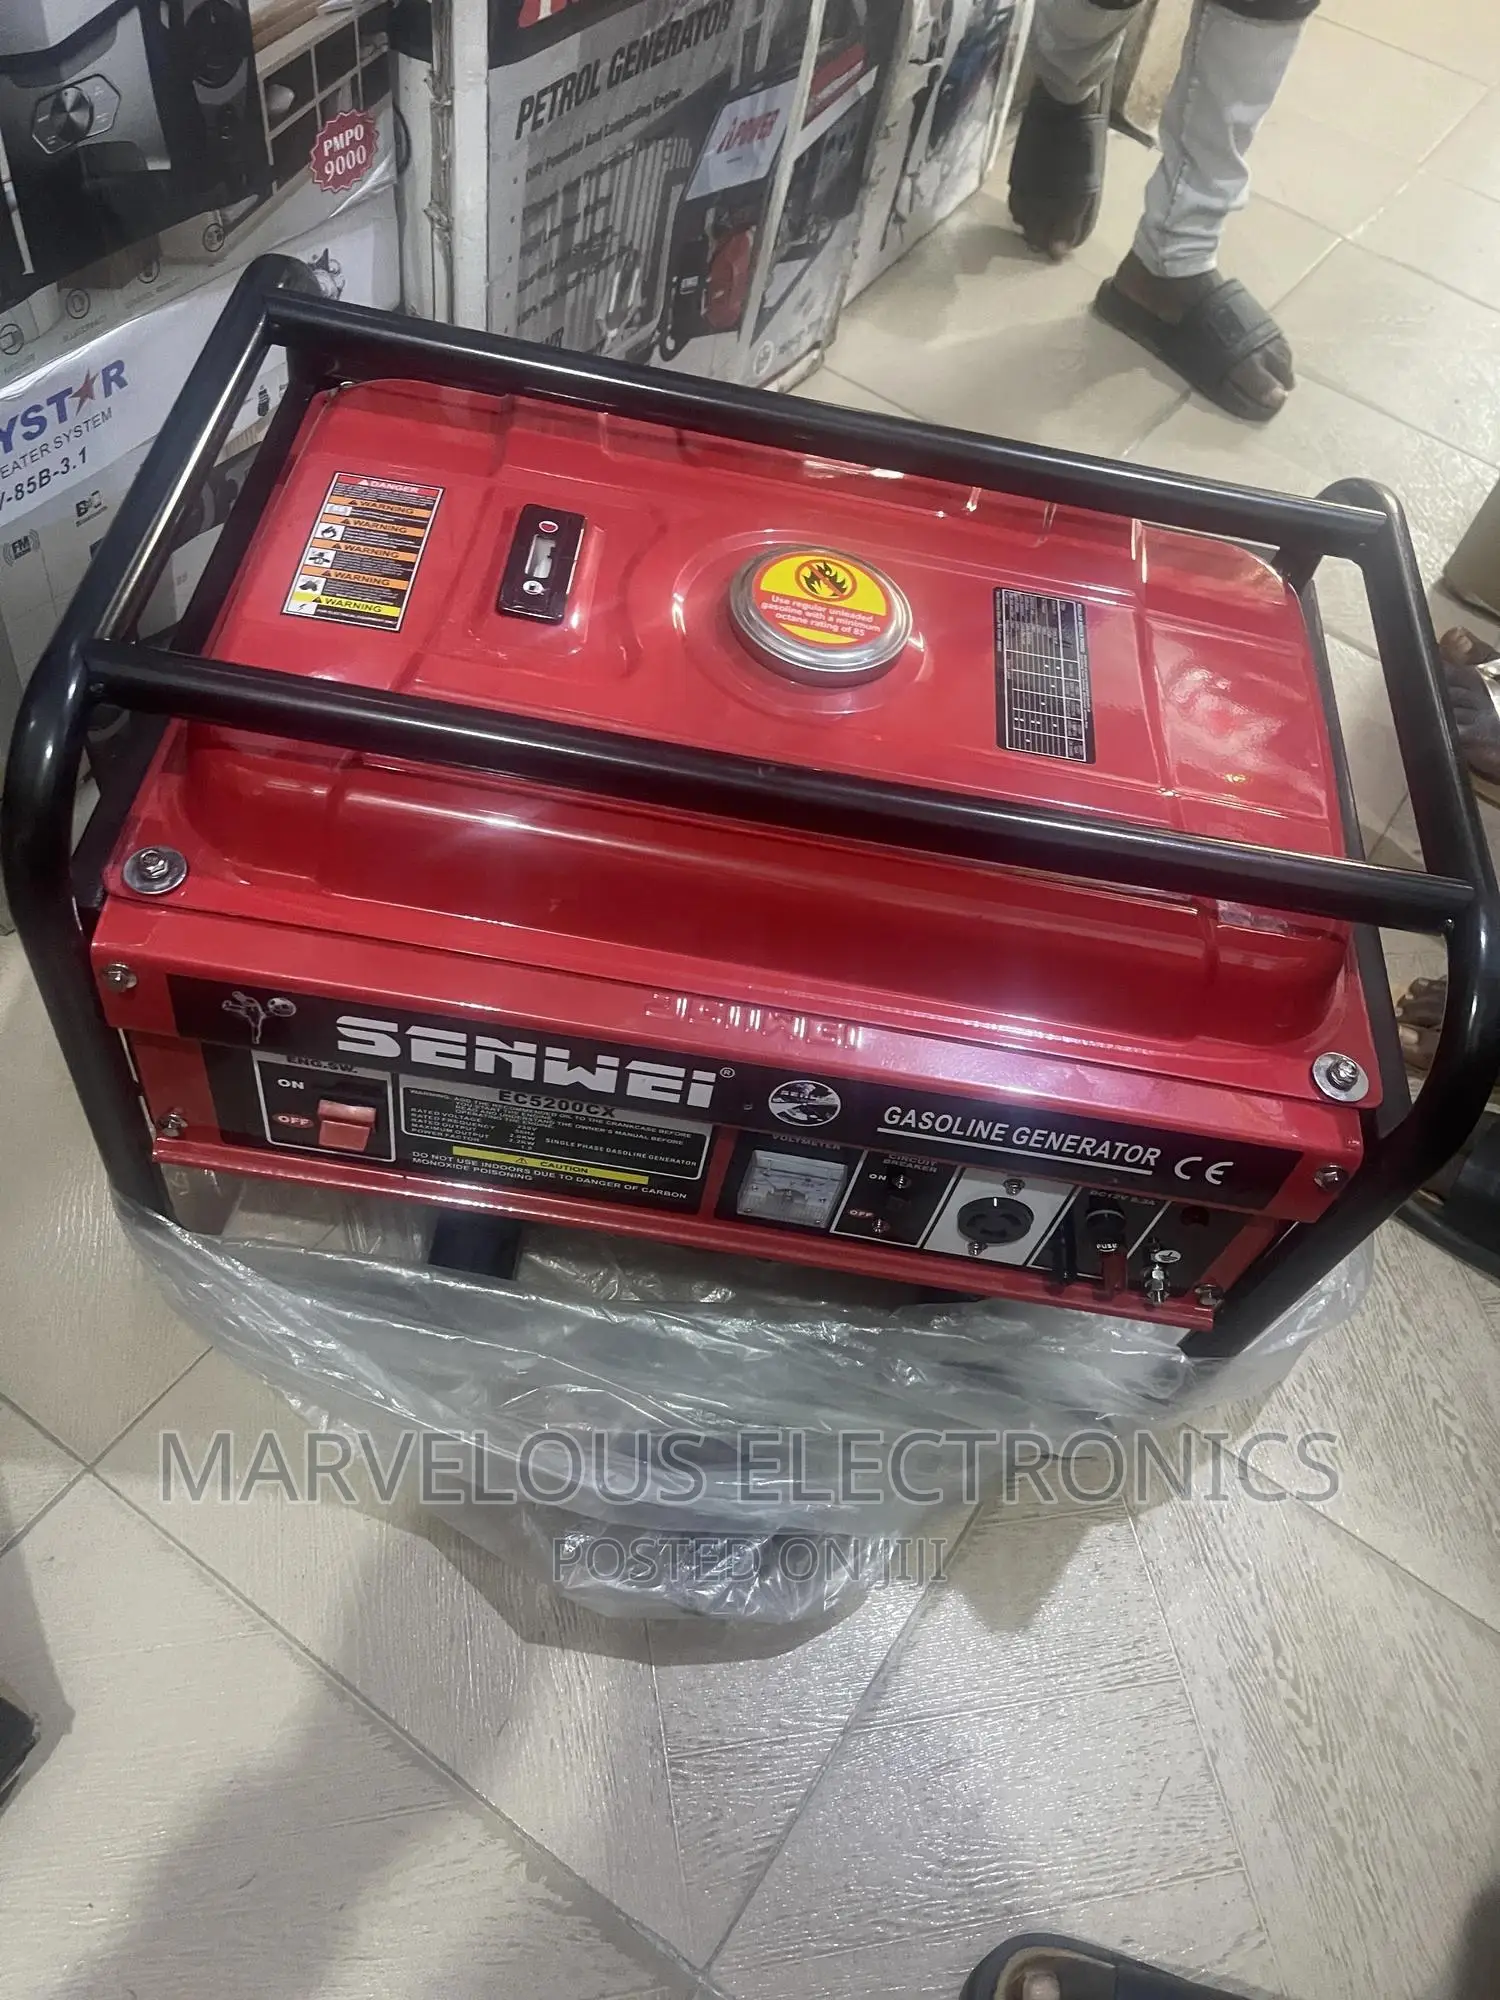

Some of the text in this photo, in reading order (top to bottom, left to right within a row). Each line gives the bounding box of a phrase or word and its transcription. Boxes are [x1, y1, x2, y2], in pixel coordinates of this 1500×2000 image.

[515, 1, 736, 140] PETROL GENERATOR
[323, 124, 364, 157] PMPO
[324, 145, 367, 182] 9000
[54, 406, 113, 450] SYSTEM
[369, 480, 420, 494] DANGER
[361, 500, 415, 515] WARNING
[353, 519, 408, 534] WARNING
[344, 544, 400, 559] WARNING
[334, 571, 391, 586] WARNING
[325, 597, 383, 613] WARNING
[771, 594, 873, 623] Use regular unleaded
[760, 602, 803, 617] gasoline
[805, 611, 826, 621] with
[836, 617, 881, 633] minimum
[775, 612, 866, 637] octane rating of 85
[336, 1015, 717, 1108] SENWEI
[278, 1079, 305, 1090] ON
[498, 1090, 617, 1119] EC5200CX
[278, 1115, 310, 1126] OFF
[410, 1107, 440, 1116] RATED
[441, 1112, 482, 1123] VOLTAGE
[410, 1112, 440, 1122] RATED
[441, 1117, 496, 1130] FREQUENCY
[410, 1117, 440, 1127] RATED
[441, 1122, 477, 1132] OUTPUT
[411, 1122, 453, 1133] MAXIMUM
[454, 1130, 490, 1139] OUTPUT
[557, 1120, 573, 1128] THE
[615, 1129, 649, 1140] MANUAL
[650, 1135, 684, 1146] BEFORE
[588, 1117, 605, 1125] THE
[606, 1119, 657, 1133] CRANKCASE
[658, 1128, 692, 1139] BEFORE
[411, 1128, 443, 1138] POWER
[444, 1132, 480, 1143] FACTOR
[883, 1105, 1162, 1167] GASOLINE GENERATOR
[545, 1137, 575, 1148] SINGLE
[576, 1143, 604, 1153] PHASE
[648, 1154, 697, 1167] GENERATOR
[887, 1153, 938, 1166] CIRCUIT
[412, 1157, 534, 1181] MONOXIDE POISONING
[540, 1160, 589, 1174] CAUTION
[881, 1158, 938, 1174] BREAKER
[1174, 1156, 1235, 1185] CE
[412, 1151, 429, 1159] DO
[430, 1153, 453, 1162] NOT
[456, 1158, 479, 1167] USE
[481, 1161, 531, 1175] INDOORS
[533, 1169, 556, 1179] DUE
[559, 1174, 573, 1182] TO
[575, 1176, 622, 1190] DANGER
[641, 1187, 687, 1200] CARBON
[868, 1173, 887, 1181] ON
[849, 1209, 874, 1218] OFF
